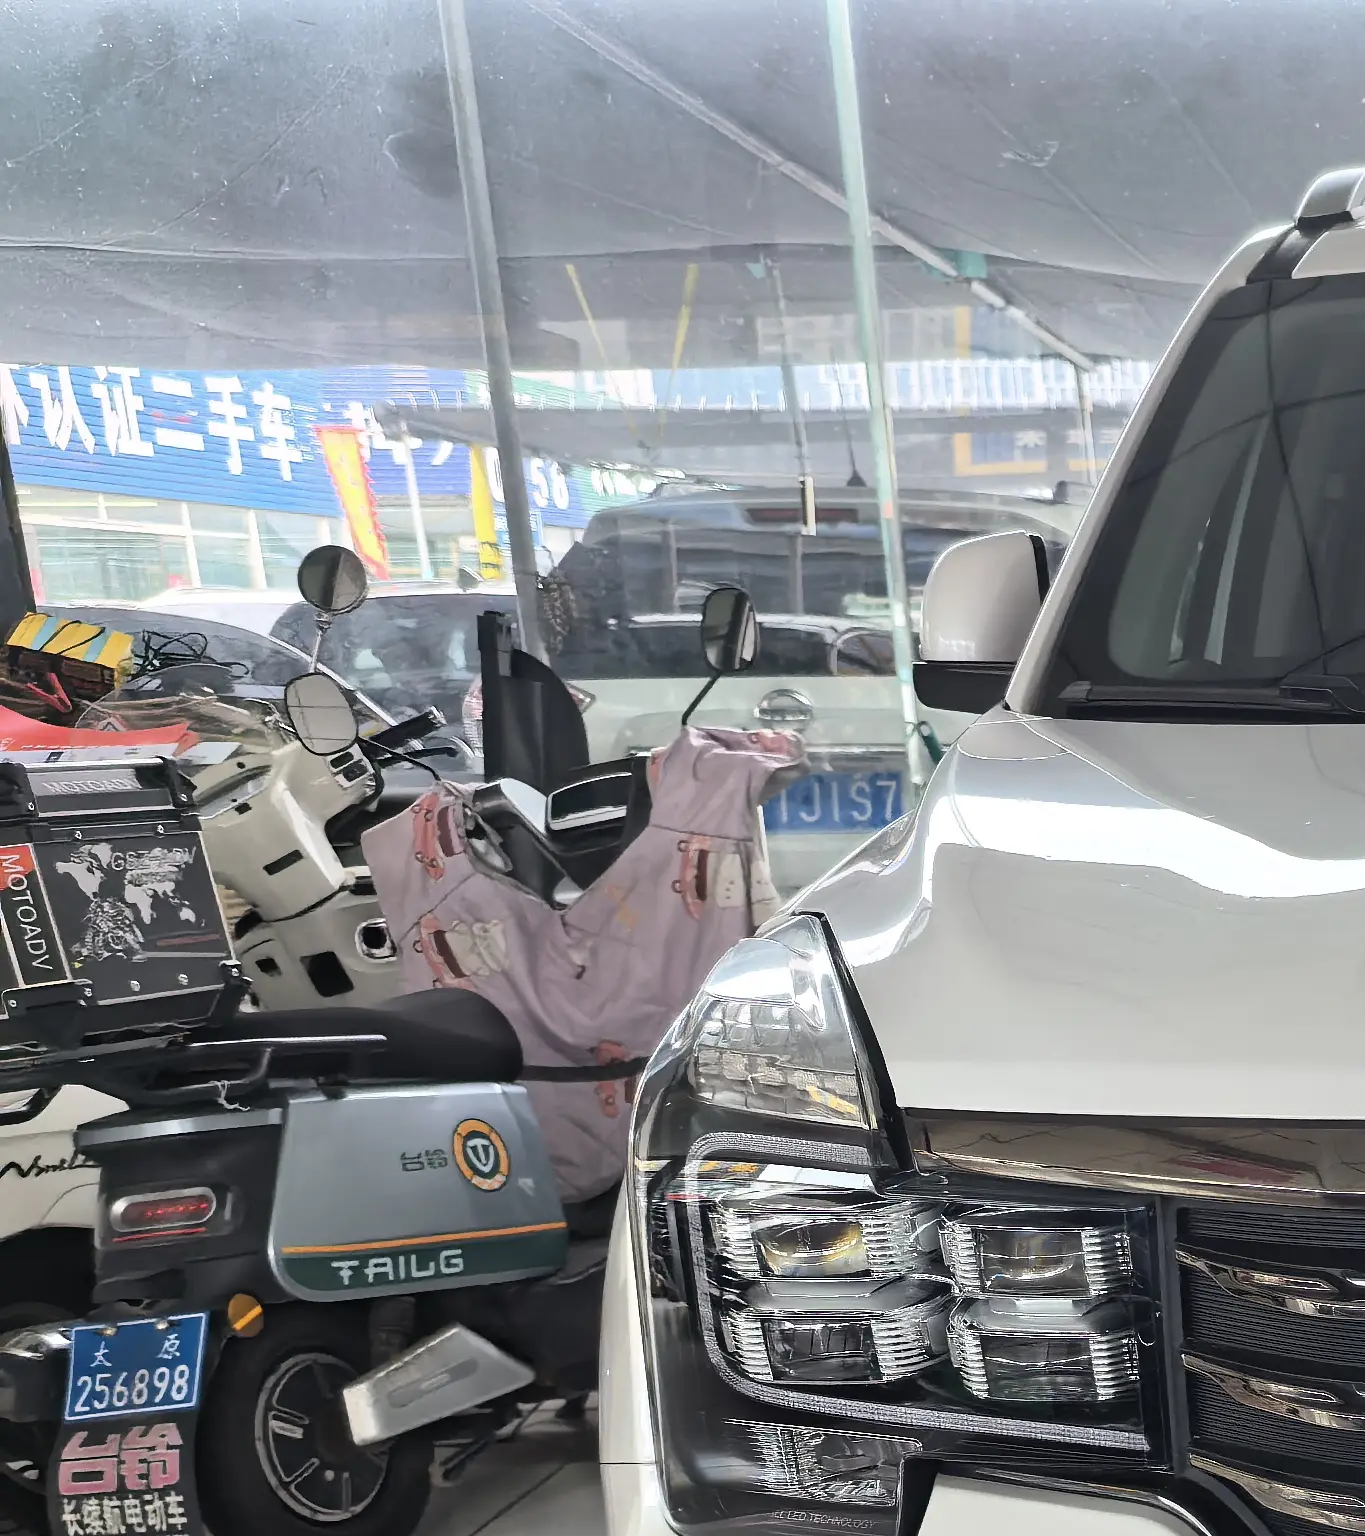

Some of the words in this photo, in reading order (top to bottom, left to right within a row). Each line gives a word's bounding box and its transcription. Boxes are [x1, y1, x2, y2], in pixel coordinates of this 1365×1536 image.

[0, 853, 54, 971] MOTOADV
[330, 1249, 465, 1285] TAILG
[74, 1364, 190, 1412] 256898
[58, 1422, 183, 1495] 台铃
[61, 1490, 188, 1536] 长续航电动车
